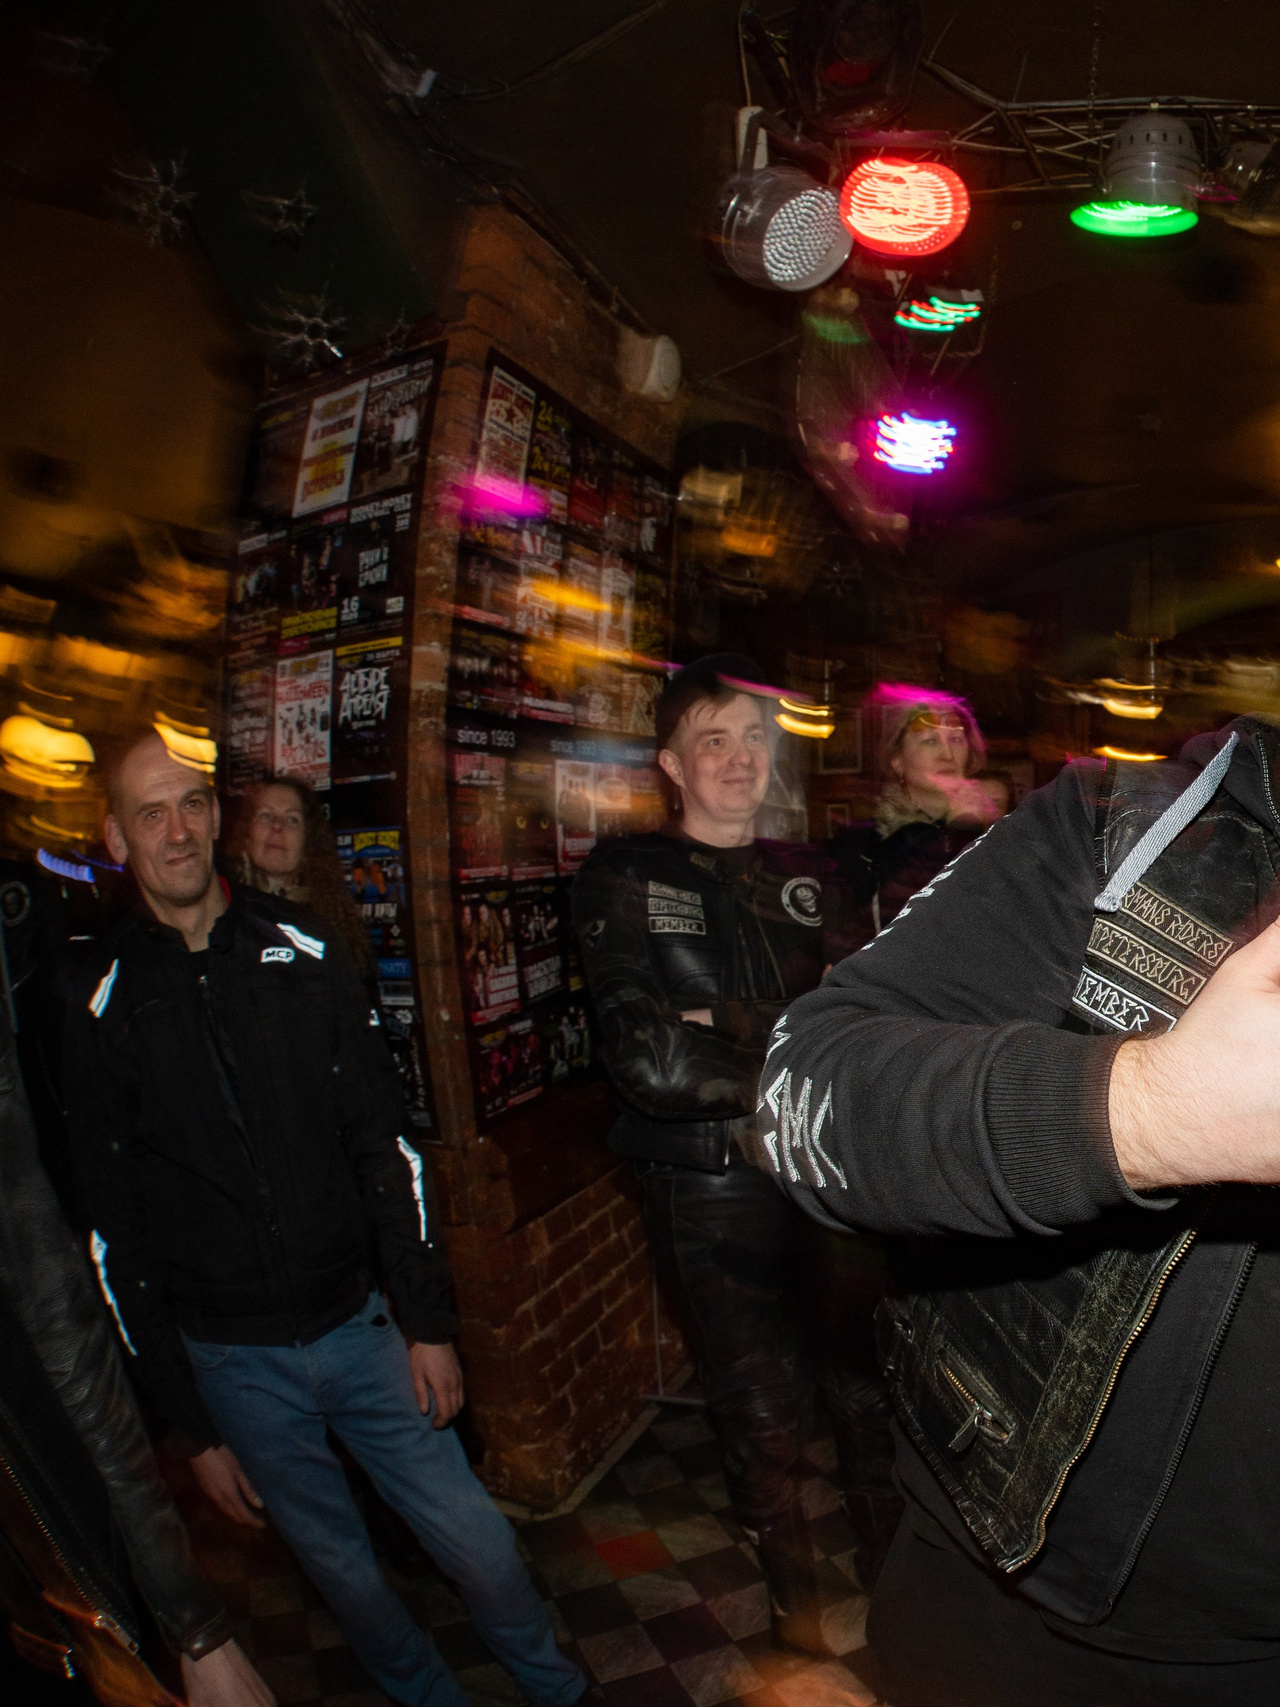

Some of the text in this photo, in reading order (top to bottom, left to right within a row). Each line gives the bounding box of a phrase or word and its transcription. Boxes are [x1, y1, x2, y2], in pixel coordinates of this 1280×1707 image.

[457, 726, 516, 748] since 1993
[1124, 888, 1224, 959] RMANS RIDERS
[265, 949, 293, 960] MCP
